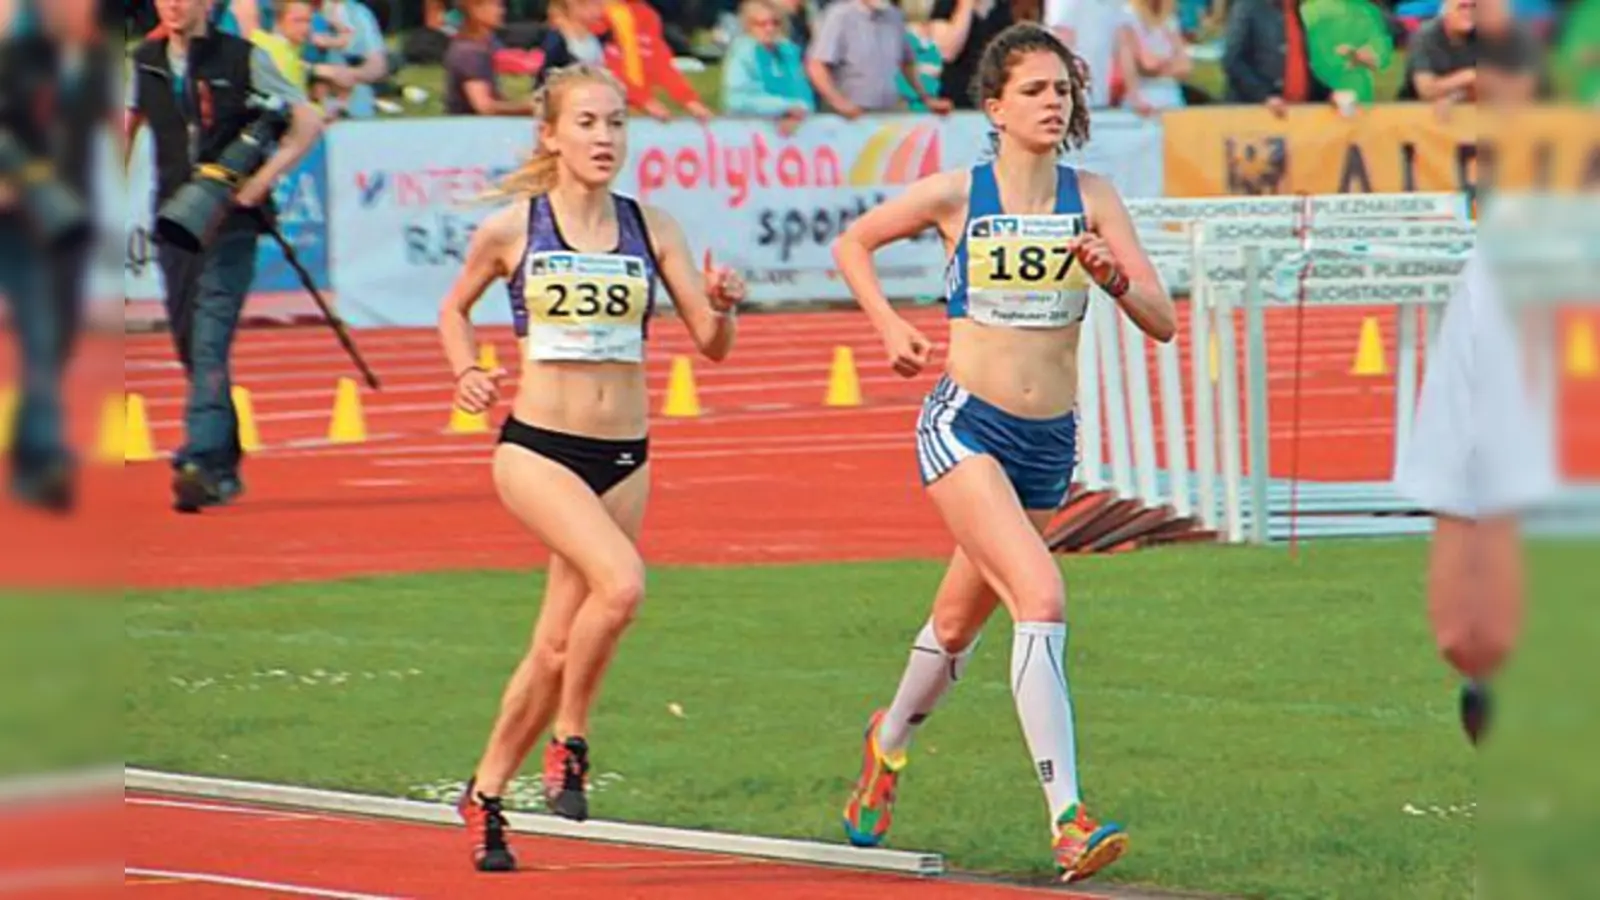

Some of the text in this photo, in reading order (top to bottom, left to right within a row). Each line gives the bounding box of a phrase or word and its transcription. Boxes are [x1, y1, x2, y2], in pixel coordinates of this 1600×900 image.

[637, 128, 841, 208] polytan
[989, 246, 1076, 282] 187
[545, 282, 631, 317] 238
